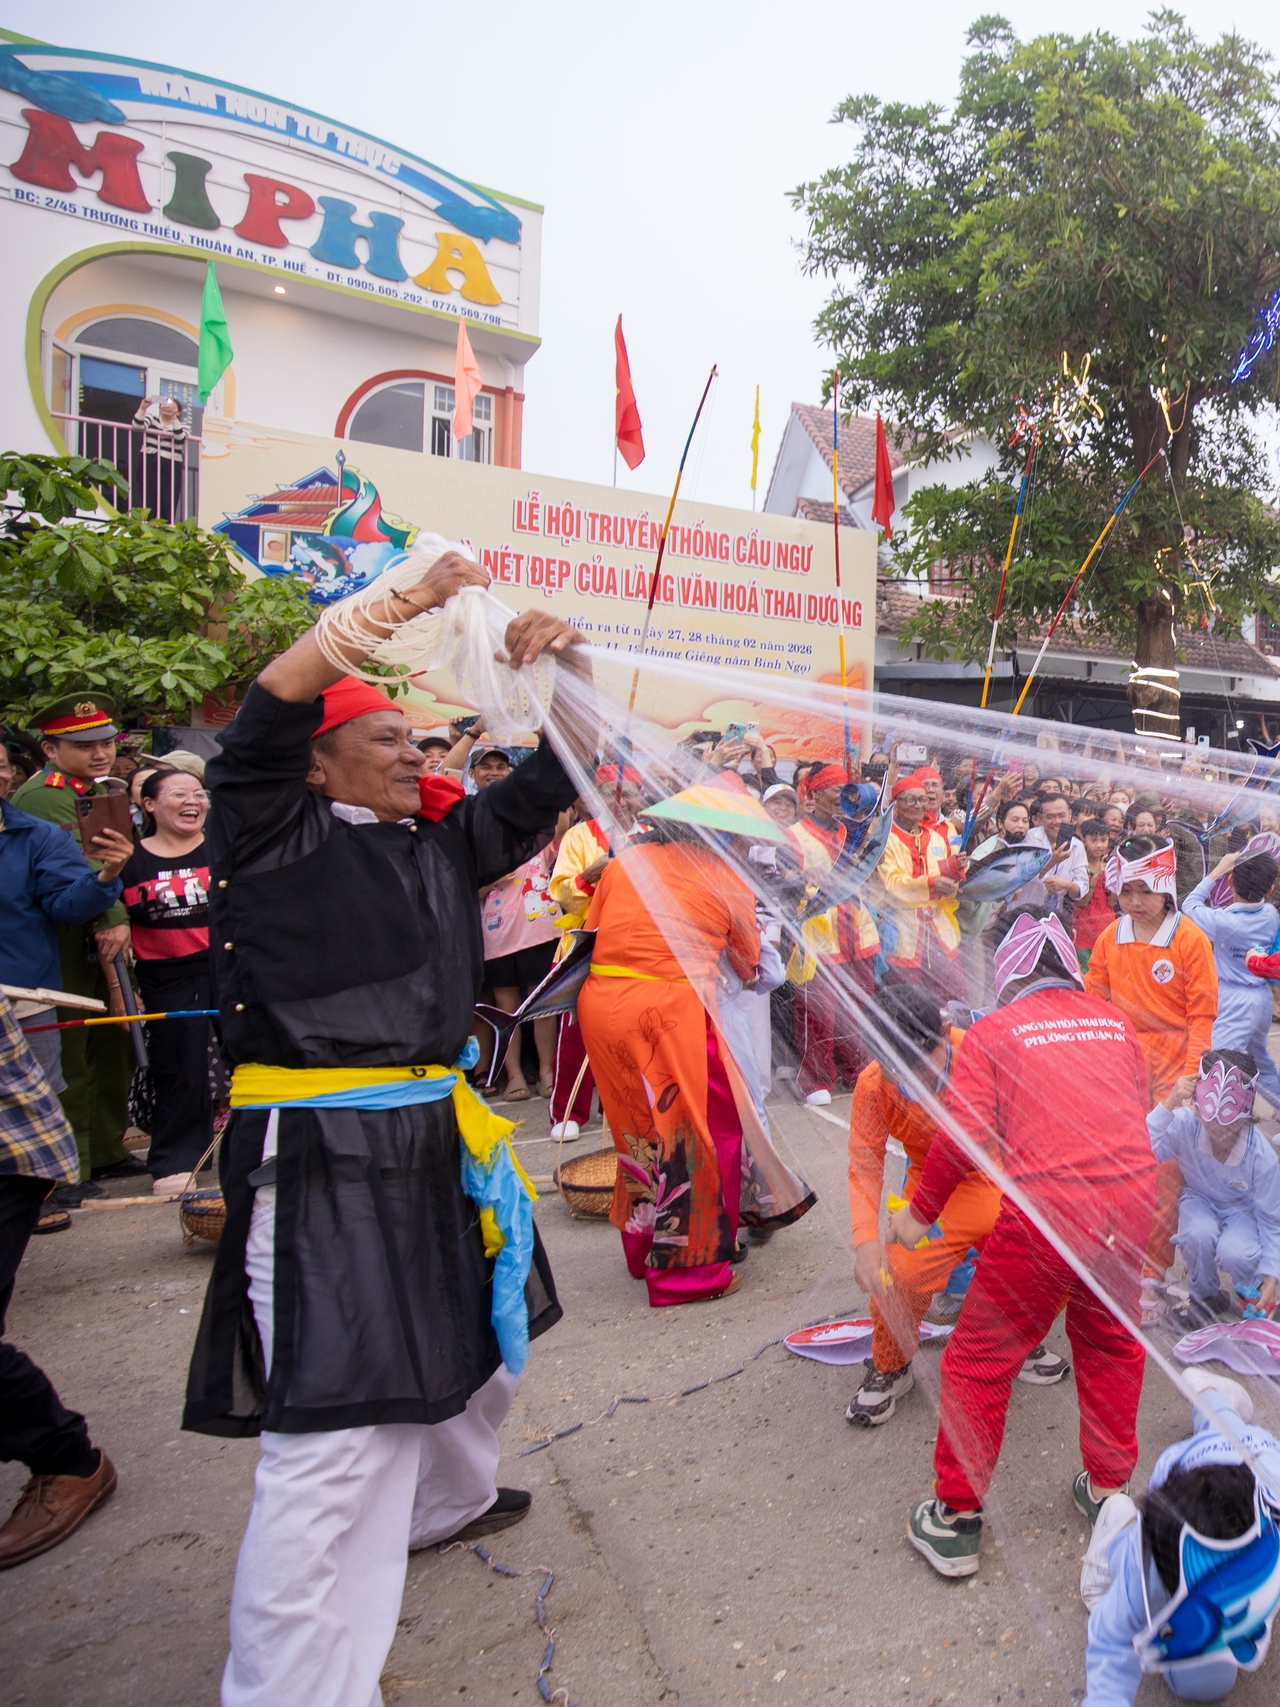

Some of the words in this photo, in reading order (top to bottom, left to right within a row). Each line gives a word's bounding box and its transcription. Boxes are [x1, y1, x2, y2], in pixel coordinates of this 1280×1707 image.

[225, 95, 288, 131] NON
[9, 108, 502, 306] MIPHA
[14, 187, 40, 205] ĐC:
[45, 196, 77, 215] 2/45
[82, 206, 139, 230] TRƯƠNG
[236, 249, 257, 262] AN,
[262, 254, 278, 267] TP.
[283, 260, 307, 275] HUẾ
[327, 271, 344, 284] ĐT:
[347, 277, 423, 304] 0905.605.292
[514, 490, 541, 533] LỄ
[547, 501, 582, 545] HỘI
[587, 511, 664, 550] TRUYỀN
[669, 519, 730, 562] THỐNG
[735, 528, 771, 568] CẦU
[776, 542, 814, 574] NGƯ
[482, 545, 524, 583] NÉT
[529, 556, 571, 595] ĐẸP
[577, 554, 618, 598] CỦA
[624, 564, 675, 604] LÀNG
[680, 573, 717, 610] VĂN
[722, 580, 759, 614] HOÁ
[763, 588, 802, 620] THAI
[807, 593, 863, 628] DƯƠNG
[597, 624, 611, 633] ra
[615, 623, 630, 635] từ
[667, 629, 685, 643] 27,
[688, 632, 702, 643] 28
[705, 633, 740, 649] tháng
[743, 637, 756, 649] 02
[760, 640, 785, 653] năm
[787, 643, 813, 656] 2026
[645, 646, 682, 660] tháng
[685, 649, 721, 665] Giêng
[724, 655, 751, 668] năm
[754, 656, 781, 670] Bính
[785, 662, 812, 675] Ngọ)
